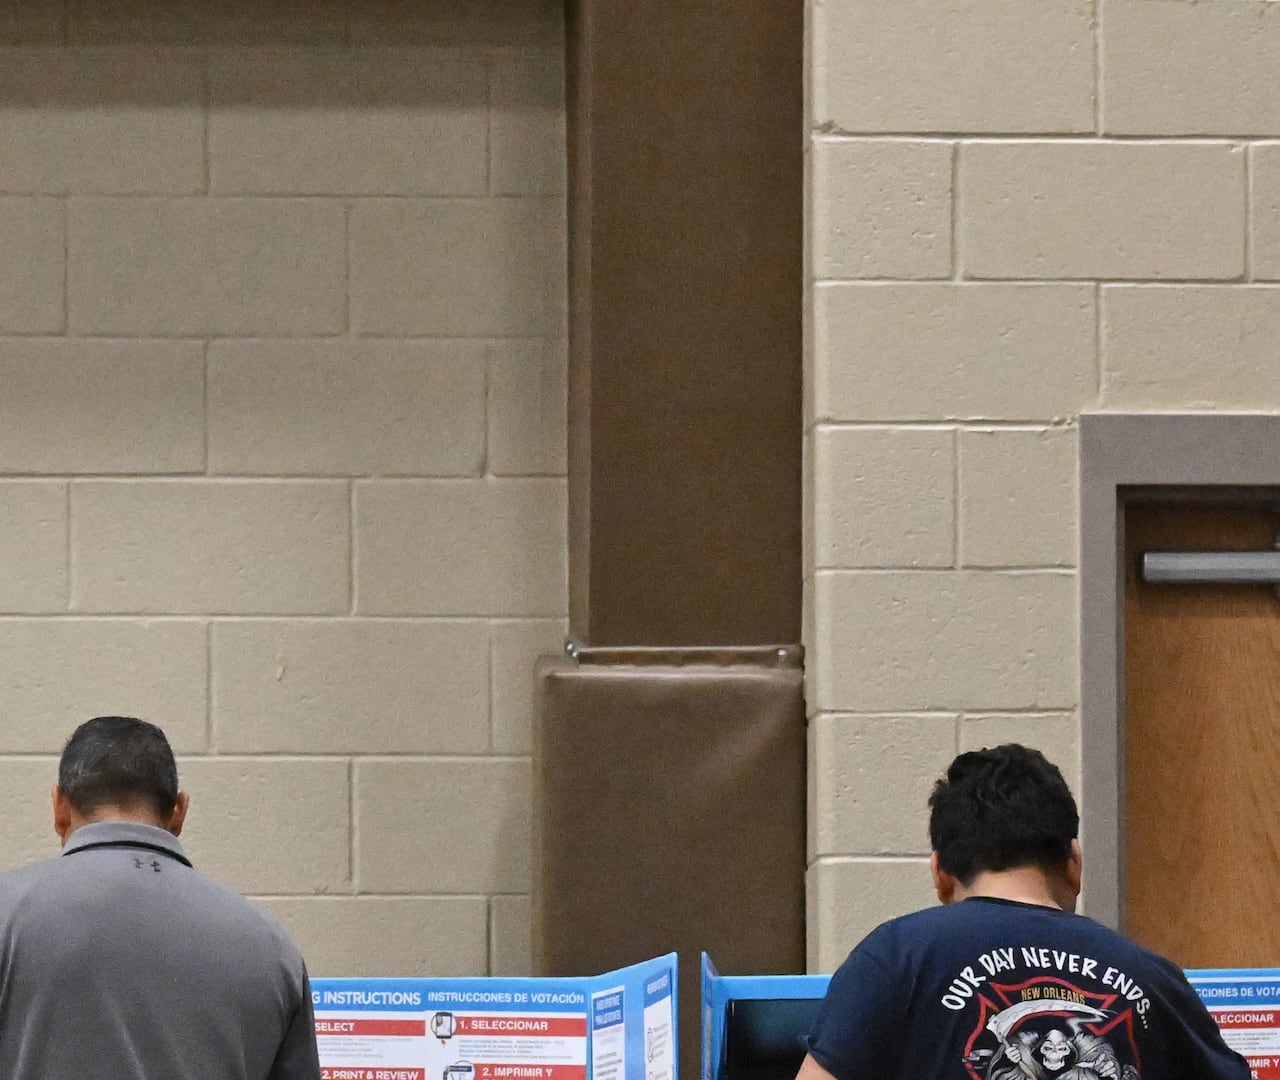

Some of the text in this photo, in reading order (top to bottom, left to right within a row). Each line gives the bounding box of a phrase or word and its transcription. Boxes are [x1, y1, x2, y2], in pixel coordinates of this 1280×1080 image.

[941, 947, 1150, 1029] OUR DAY NEVER ENDS...
[1240, 986, 1254, 997] DE
[323, 991, 421, 1005] INSTRUCTIONS
[428, 991, 584, 1004] INSTRUCCIONES DE VOTACIÓN
[1021, 987, 1086, 1005] NEW ORLEANS
[1214, 1013, 1274, 1024] LECCIONAR
[459, 1020, 548, 1031] 1. SELECCIONAR
[1272, 1058, 1280, 1068] Y
[321, 1071, 419, 1080] 2. PRINT & REVIEW
[482, 1067, 553, 1077] 2. IMPRIMIR Y
